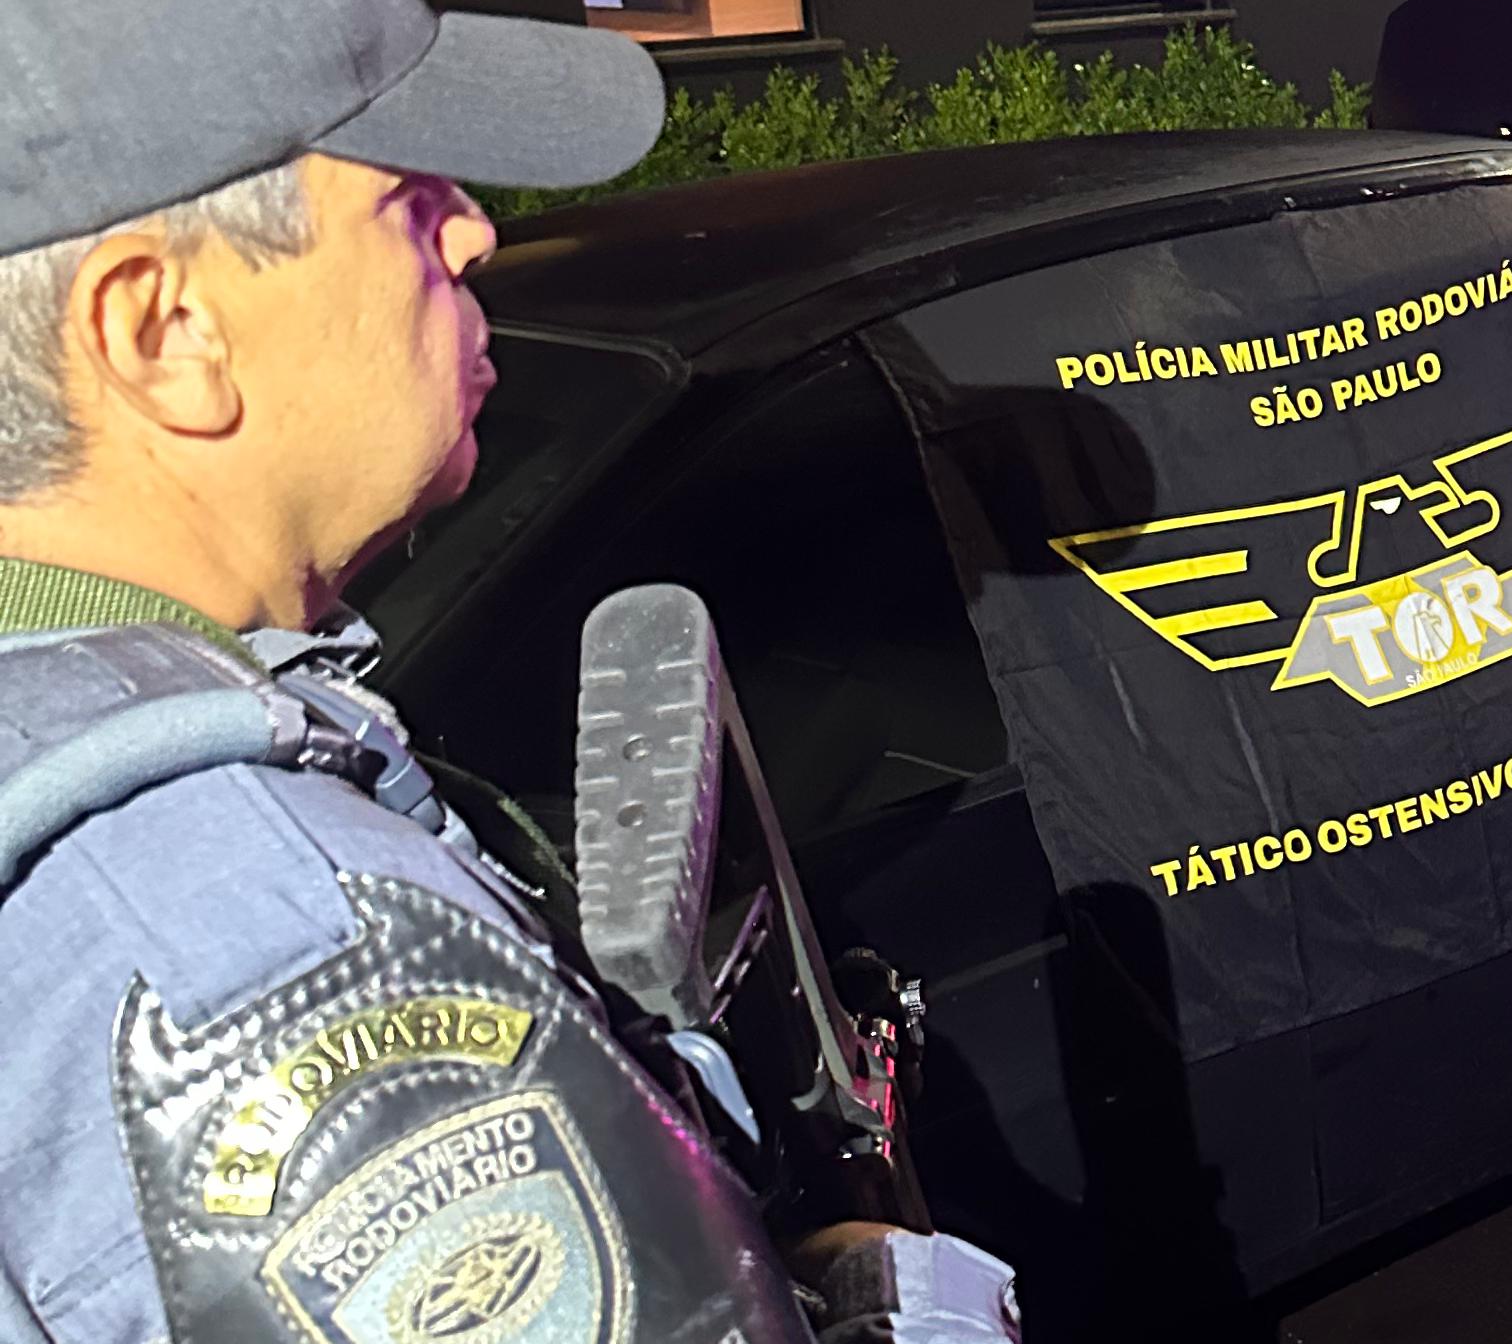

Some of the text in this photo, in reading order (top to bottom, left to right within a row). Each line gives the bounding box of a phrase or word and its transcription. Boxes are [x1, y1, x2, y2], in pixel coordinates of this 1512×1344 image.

[1056, 341, 1217, 390] POLÍCIA
[1219, 318, 1368, 376] MILITAR
[1250, 352, 1443, 428] SÃO PAULO
[1151, 830, 1313, 898] TÁTICO
